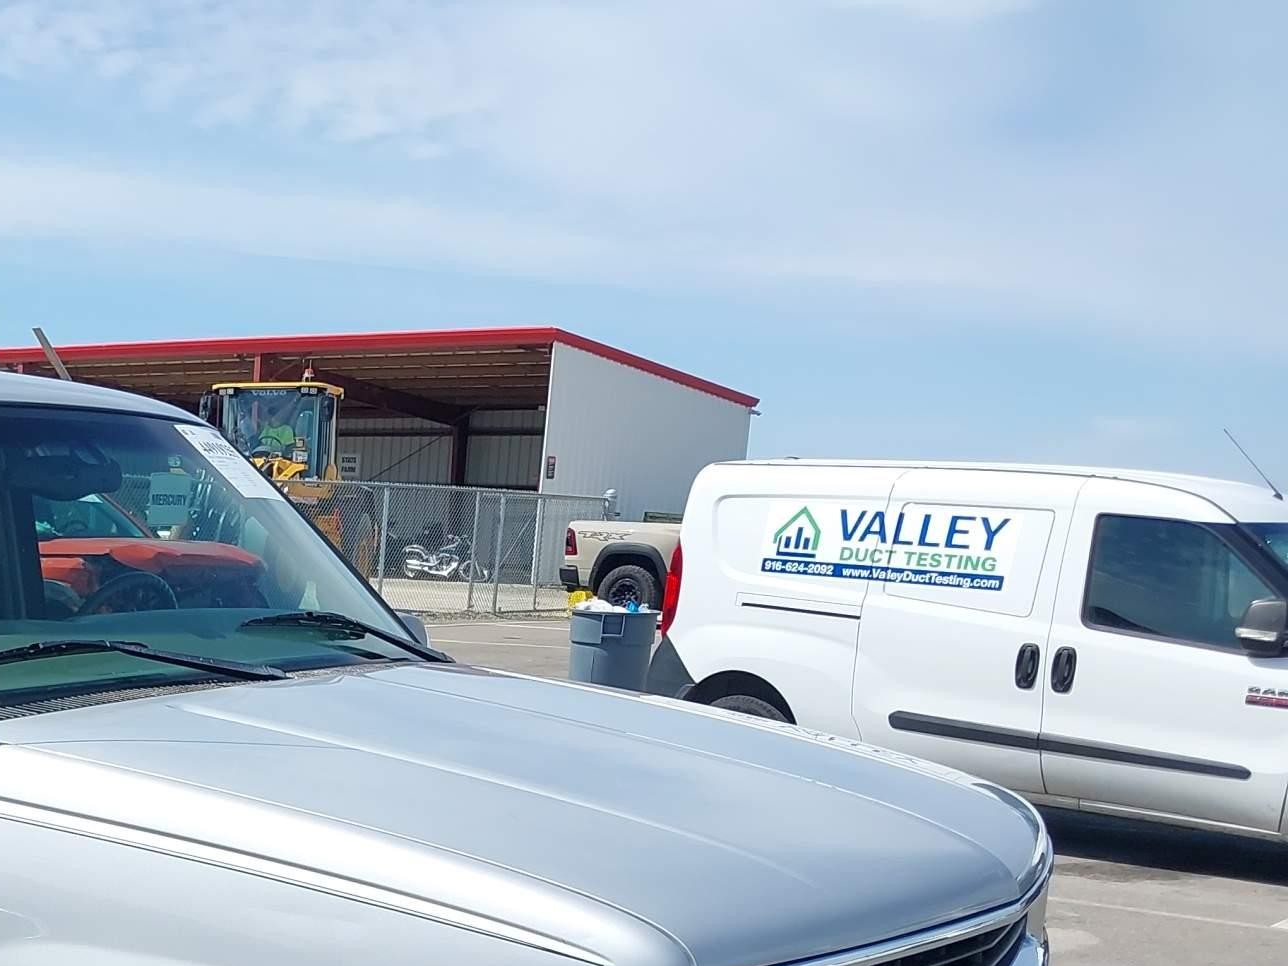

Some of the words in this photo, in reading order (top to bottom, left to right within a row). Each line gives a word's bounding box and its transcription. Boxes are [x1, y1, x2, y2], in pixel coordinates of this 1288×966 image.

[152, 493, 187, 506] MERCURY
[839, 508, 1013, 551] VALLEY
[764, 559, 834, 575] 916-624-2092
[839, 546, 896, 565] DUCT
[903, 551, 998, 573] TESTING
